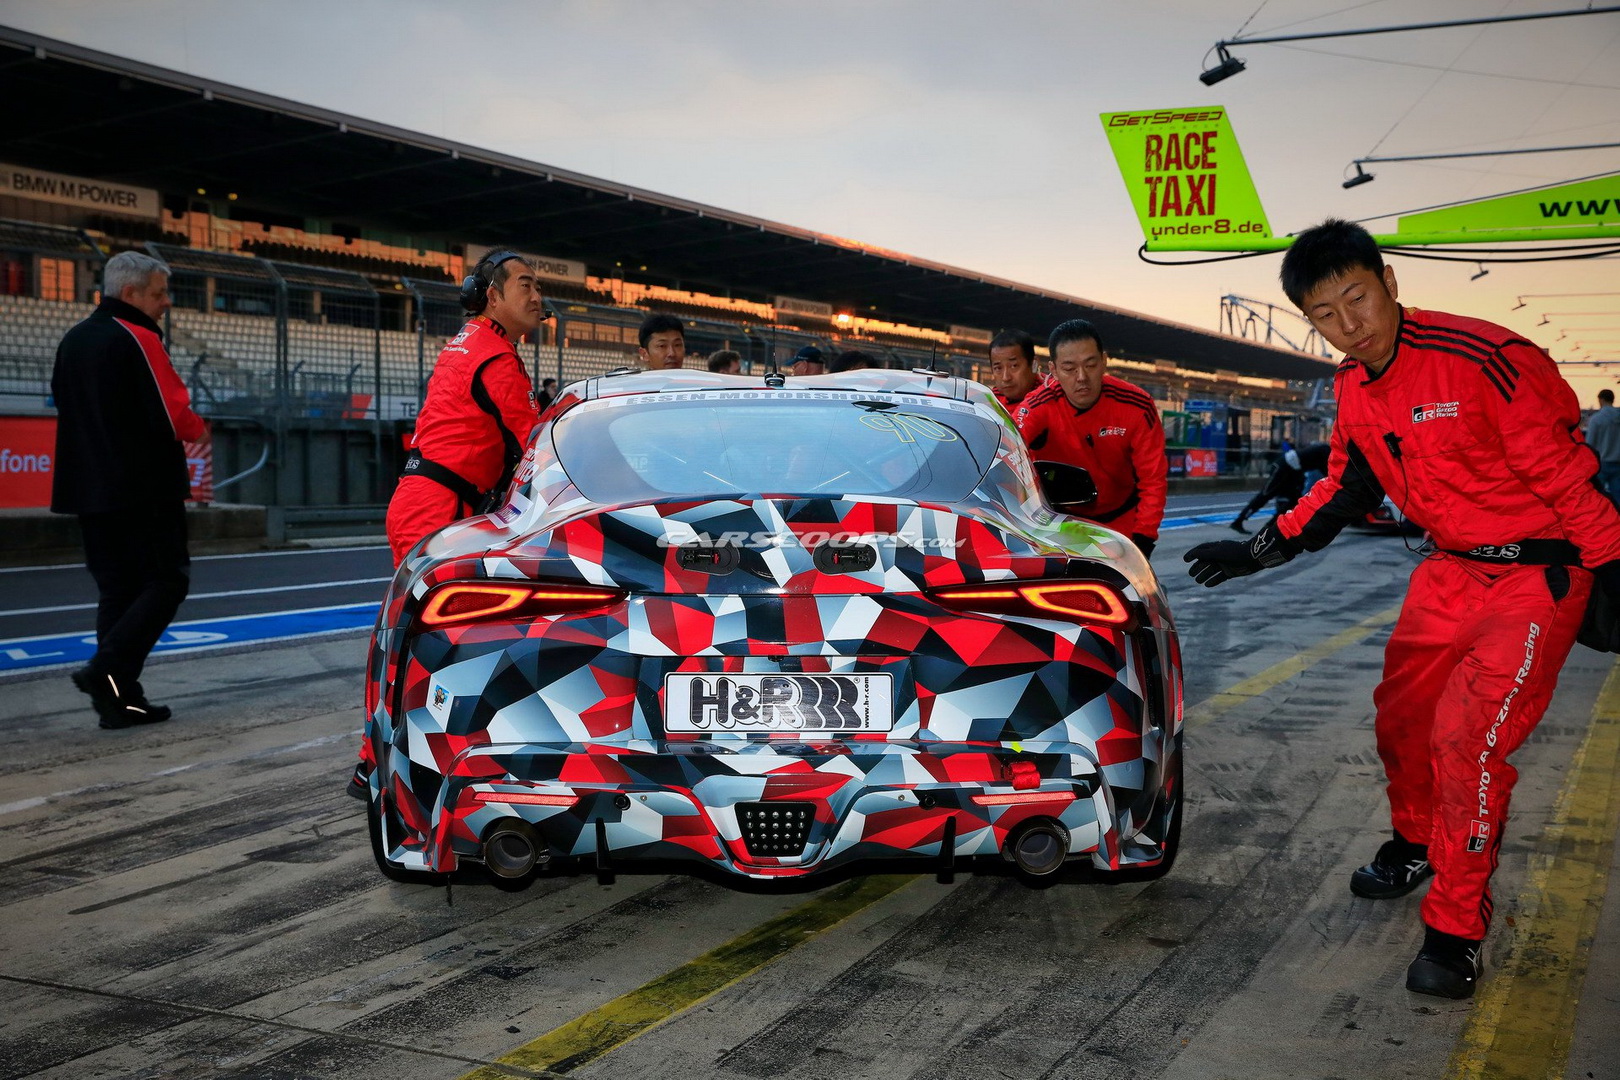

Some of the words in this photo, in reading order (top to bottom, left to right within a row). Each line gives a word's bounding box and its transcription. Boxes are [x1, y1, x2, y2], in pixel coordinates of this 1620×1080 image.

[1145, 131, 1217, 172] RACE
[13, 173, 56, 195] BMW
[60, 180, 75, 198] M
[79, 184, 137, 208] POWER
[1144, 174, 1216, 217] TAXI
[1151, 219, 1263, 236] under8.de
[538, 260, 569, 276] POWER
[401, 402, 417, 417] TE
[626, 391, 933, 407] ESSEN-MOTORSHOW.DE
[1414, 409, 1435, 422] GR
[859, 412, 957, 443] 90
[0, 449, 51, 472] fone
[1514, 622, 1540, 684] Racing
